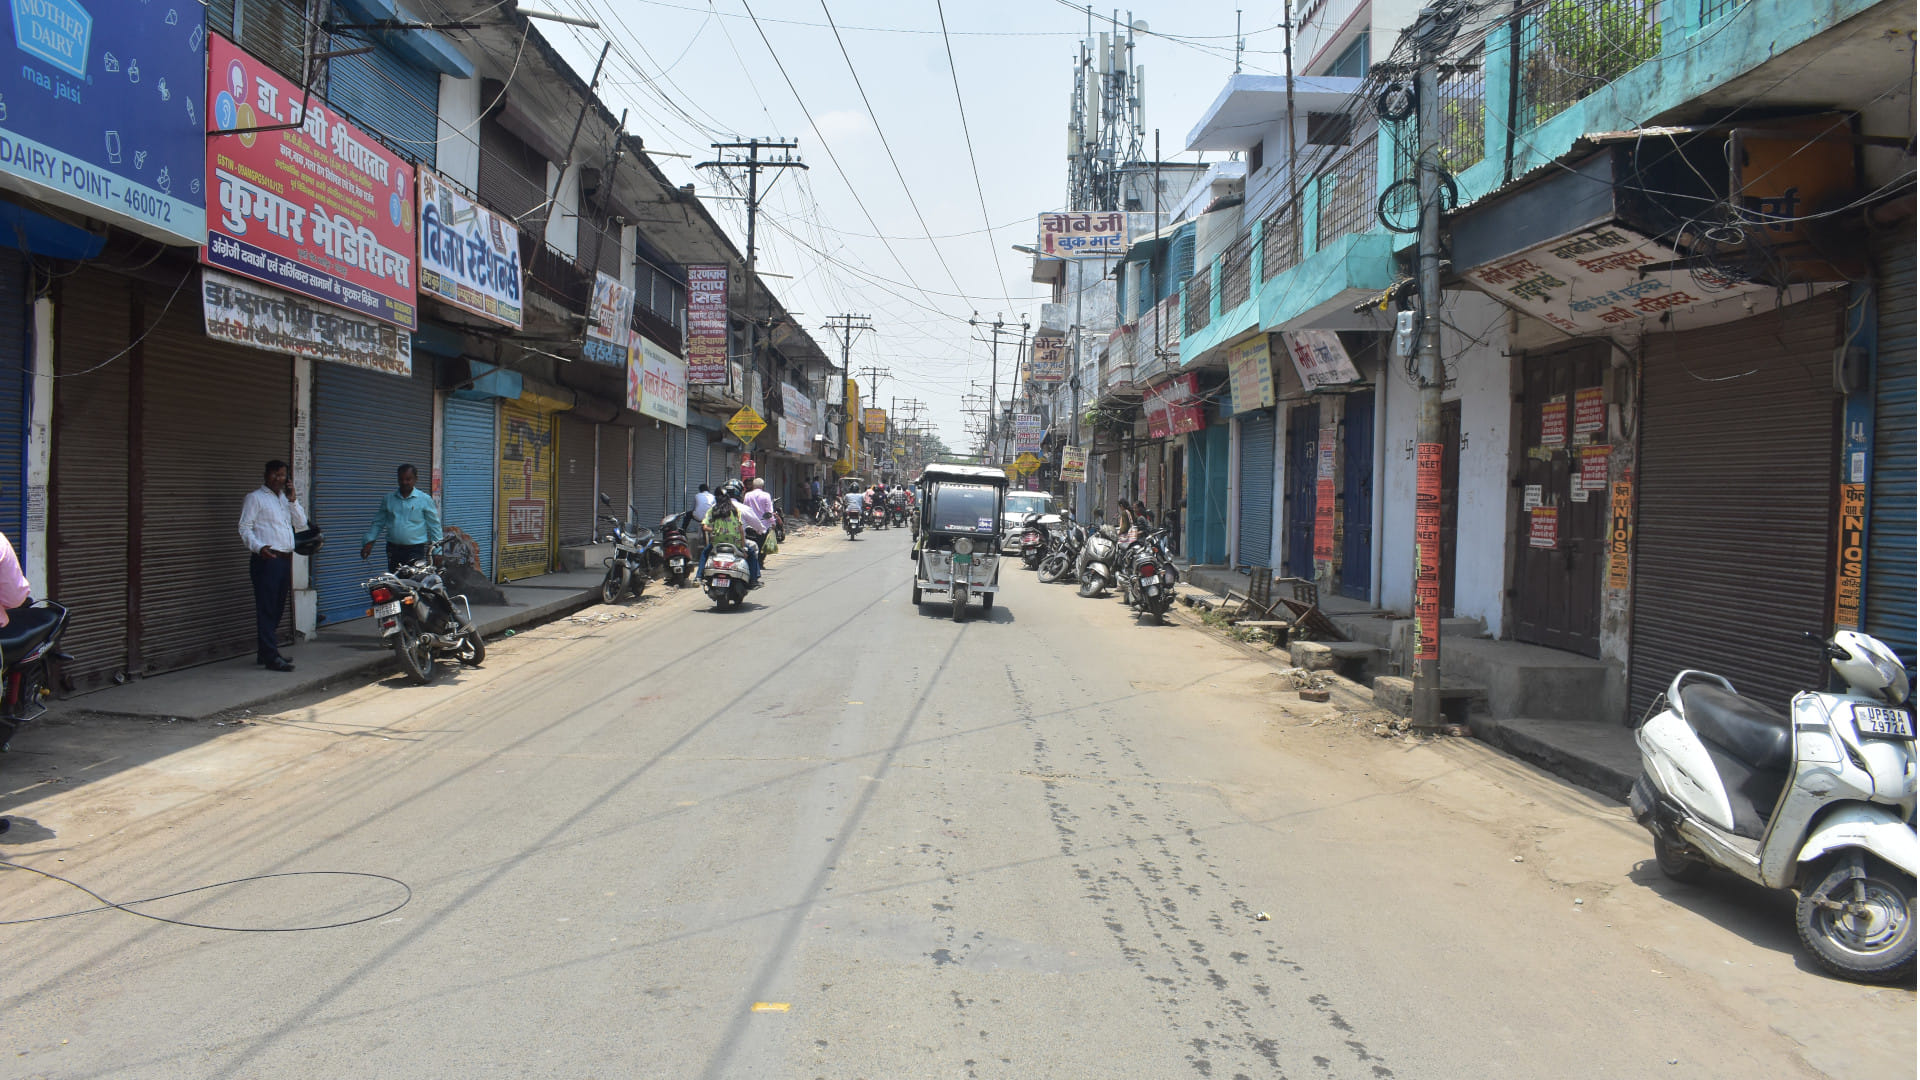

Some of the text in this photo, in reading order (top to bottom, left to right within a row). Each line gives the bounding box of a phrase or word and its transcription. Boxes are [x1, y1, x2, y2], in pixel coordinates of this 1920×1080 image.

[20, 0, 84, 47] MOTHER
[31, 20, 75, 58] DAIRY
[22, 65, 81, 105] maa jaisi
[255, 76, 284, 122] डा.
[331, 121, 389, 187] श्रीवास्तव
[0, 135, 57, 178] DAIRY
[124, 187, 172, 223] 460072
[214, 167, 309, 245] कुमार
[309, 203, 411, 290] मेडिसिन्स
[422, 203, 465, 277] विजय
[1058, 233, 1122, 250] बुक मार्ट
[211, 239, 240, 261] अंग्रेजी
[267, 257, 278, 274] एवं
[278, 261, 309, 284] सर्जिकल
[333, 280, 341, 295] के
[690, 281, 725, 291] प्रताप
[692, 291, 722, 304] सिंह
[1419, 460, 1440, 468] NEET
[1612, 506, 1628, 553] NIOS
[1843, 516, 1864, 577] NIOS
[1867, 707, 1904, 722] UP53A
